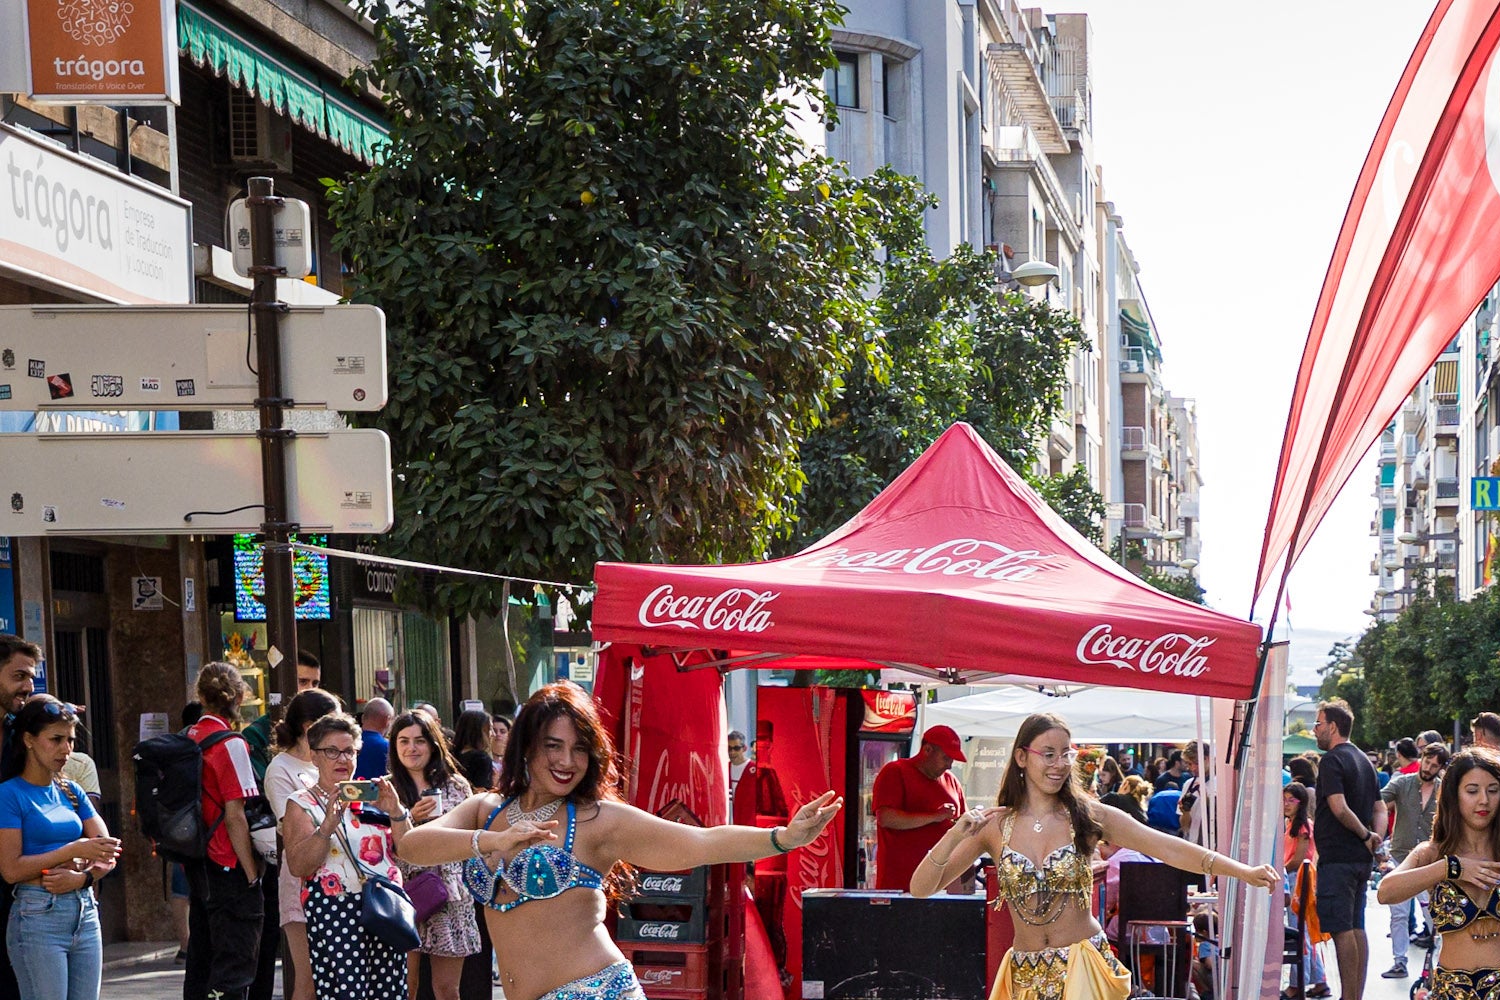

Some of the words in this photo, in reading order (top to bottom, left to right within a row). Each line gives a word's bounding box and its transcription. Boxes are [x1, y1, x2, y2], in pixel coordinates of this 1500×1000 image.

[54, 54, 145, 81] trágora
[55, 82, 97, 90] Translation
[106, 82, 125, 90] Voice
[127, 82, 146, 90] Over
[7, 151, 112, 253] trágora
[124, 199, 155, 230] Empresa
[126, 228, 135, 246] de
[135, 229, 174, 261] Traducción
[639, 584, 781, 633] Coca-Cola
[1076, 624, 1218, 678] Coca-Cola
